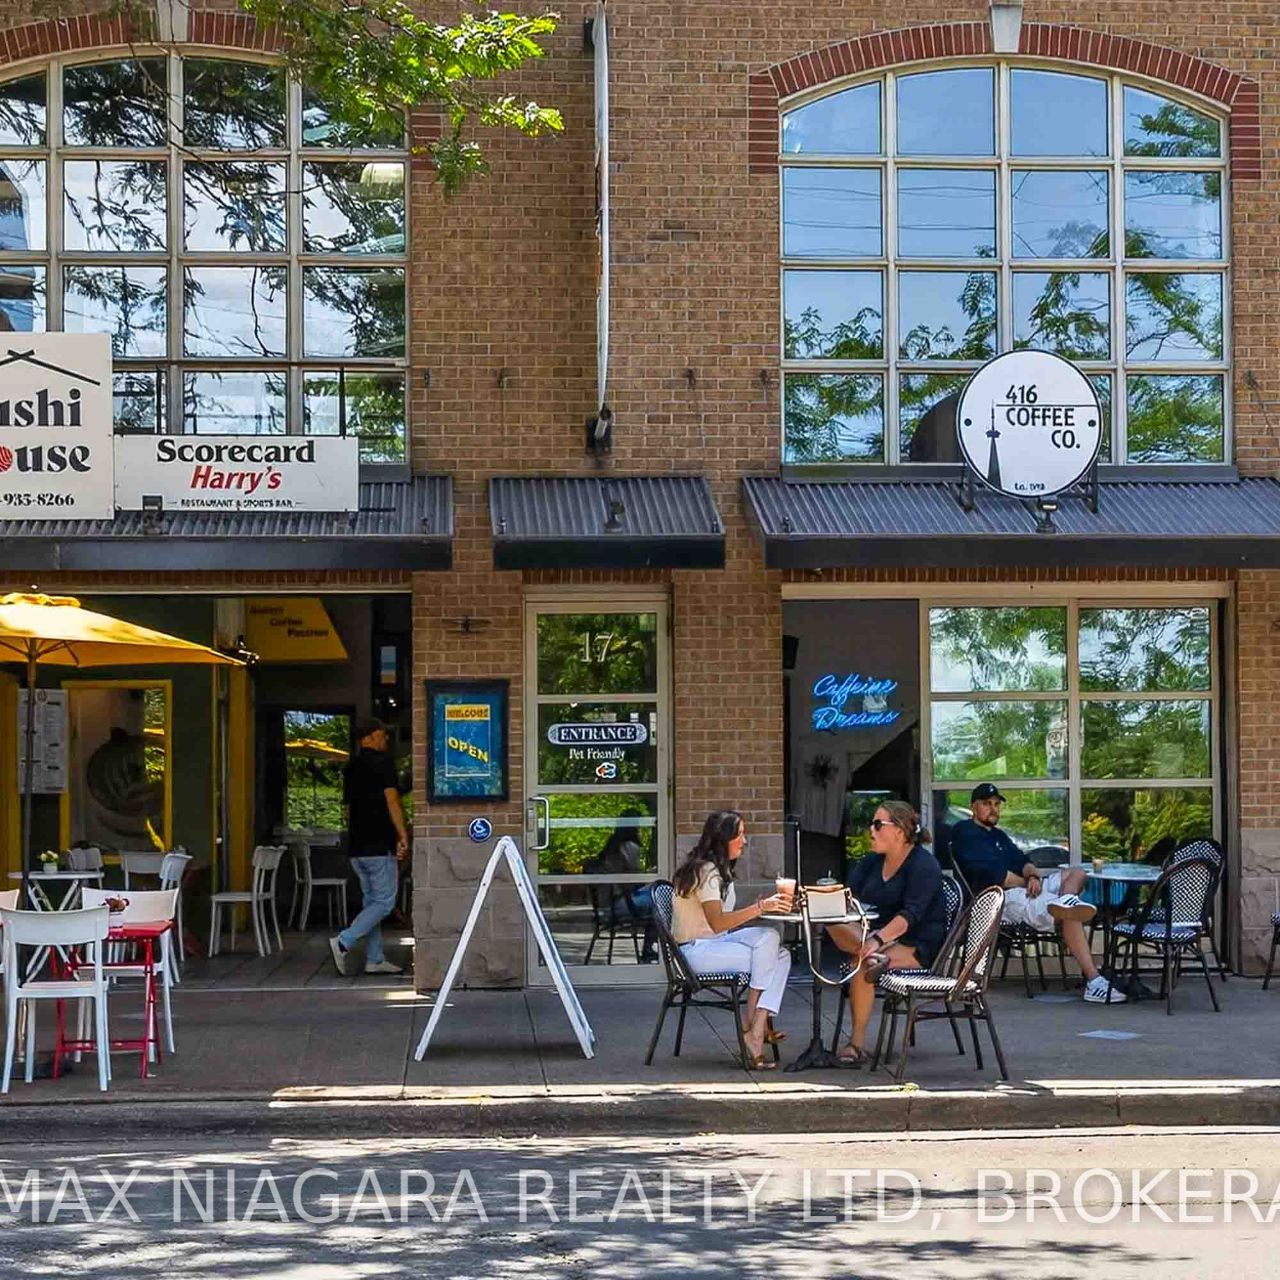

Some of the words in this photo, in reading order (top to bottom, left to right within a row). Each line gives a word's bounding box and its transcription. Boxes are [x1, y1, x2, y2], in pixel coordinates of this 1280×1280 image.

[1006, 384, 1038, 404] 416
[1006, 407, 1075, 427] COFFEE
[1051, 429, 1081, 449] CO.
[157, 439, 315, 463] Scorecard
[190, 465, 282, 494] Harry's
[580, 631, 615, 663] 17
[813, 673, 898, 706] Caffeine
[812, 706, 900, 729] Dreams
[560, 727, 635, 741] ENTRANCE
[448, 736, 488, 763] OPEN
[569, 748, 584, 760] Pet
[587, 747, 626, 762] Friendly
